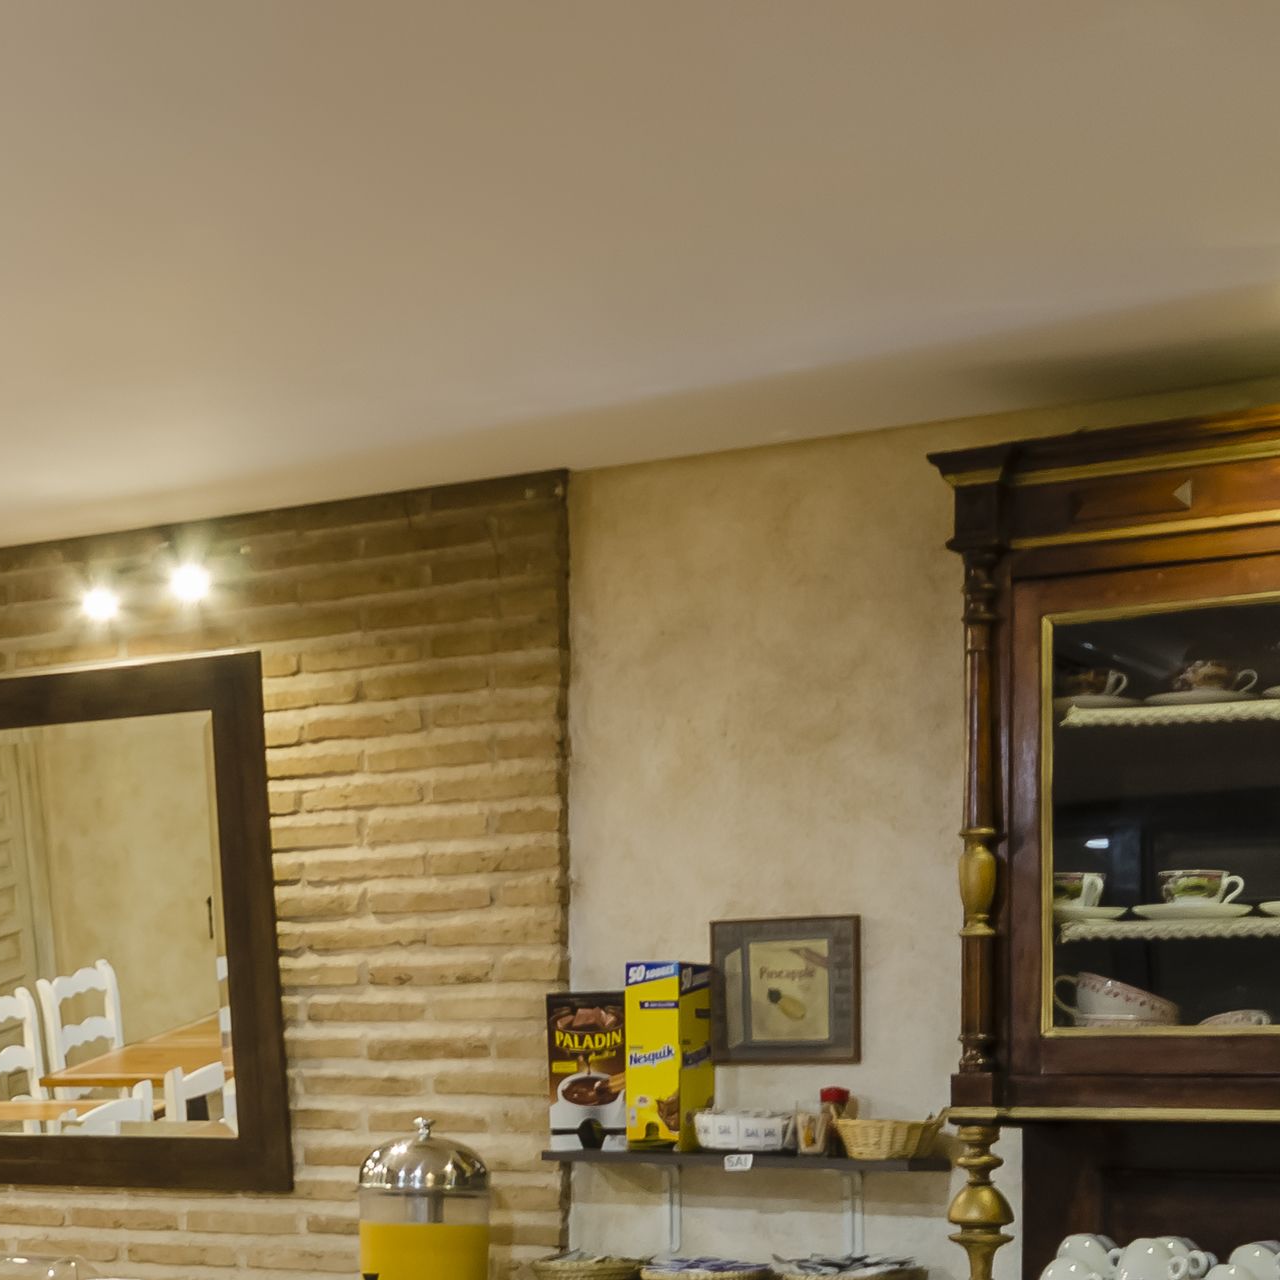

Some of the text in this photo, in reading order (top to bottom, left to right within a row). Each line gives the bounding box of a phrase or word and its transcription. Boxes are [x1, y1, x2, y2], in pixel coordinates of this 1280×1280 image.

[629, 964, 646, 984] 50
[555, 1028, 622, 1049] PALADIN
[629, 1045, 674, 1067] Nesquik
